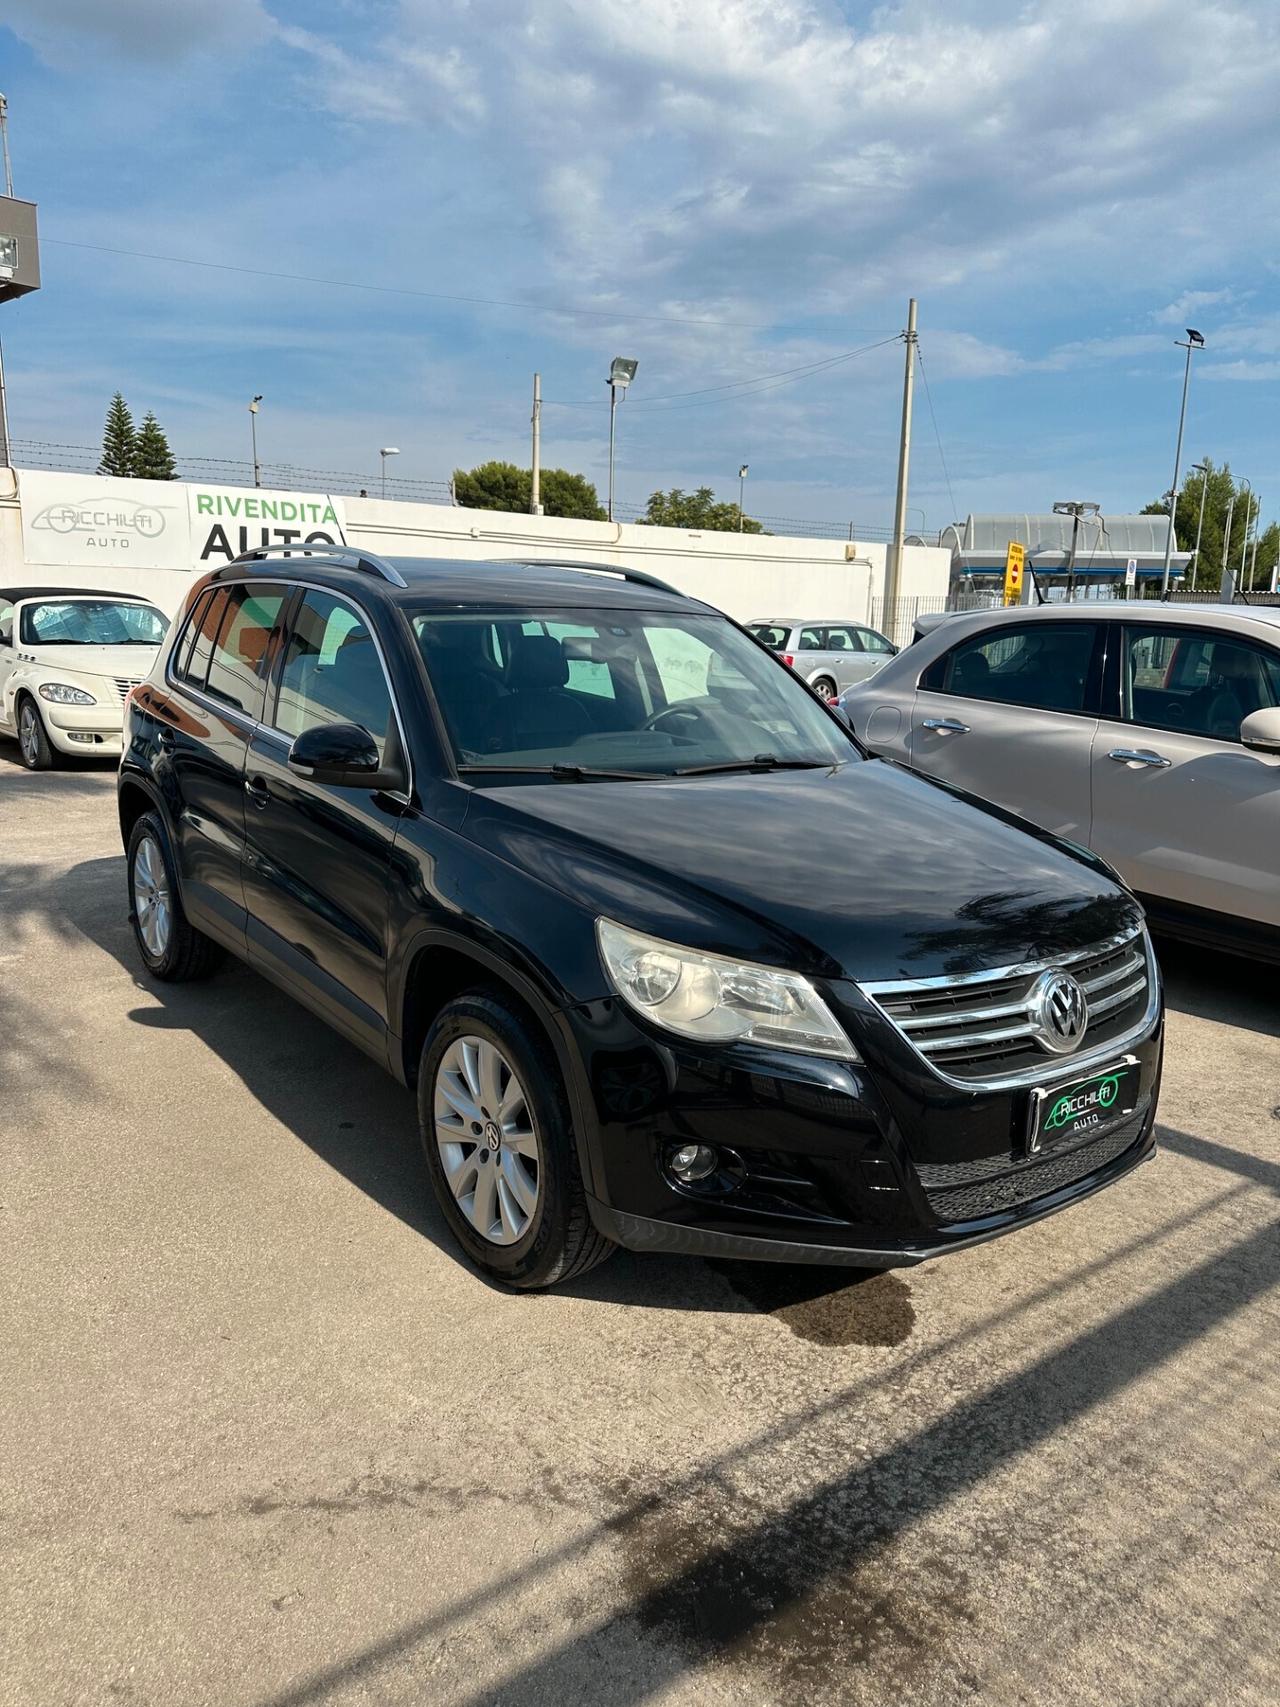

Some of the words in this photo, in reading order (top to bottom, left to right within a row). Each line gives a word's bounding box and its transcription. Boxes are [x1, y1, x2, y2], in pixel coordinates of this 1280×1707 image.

[196, 493, 337, 524] RIVENDITA
[86, 537, 129, 548] AUTO
[1073, 1113, 1099, 1130] AUTO
